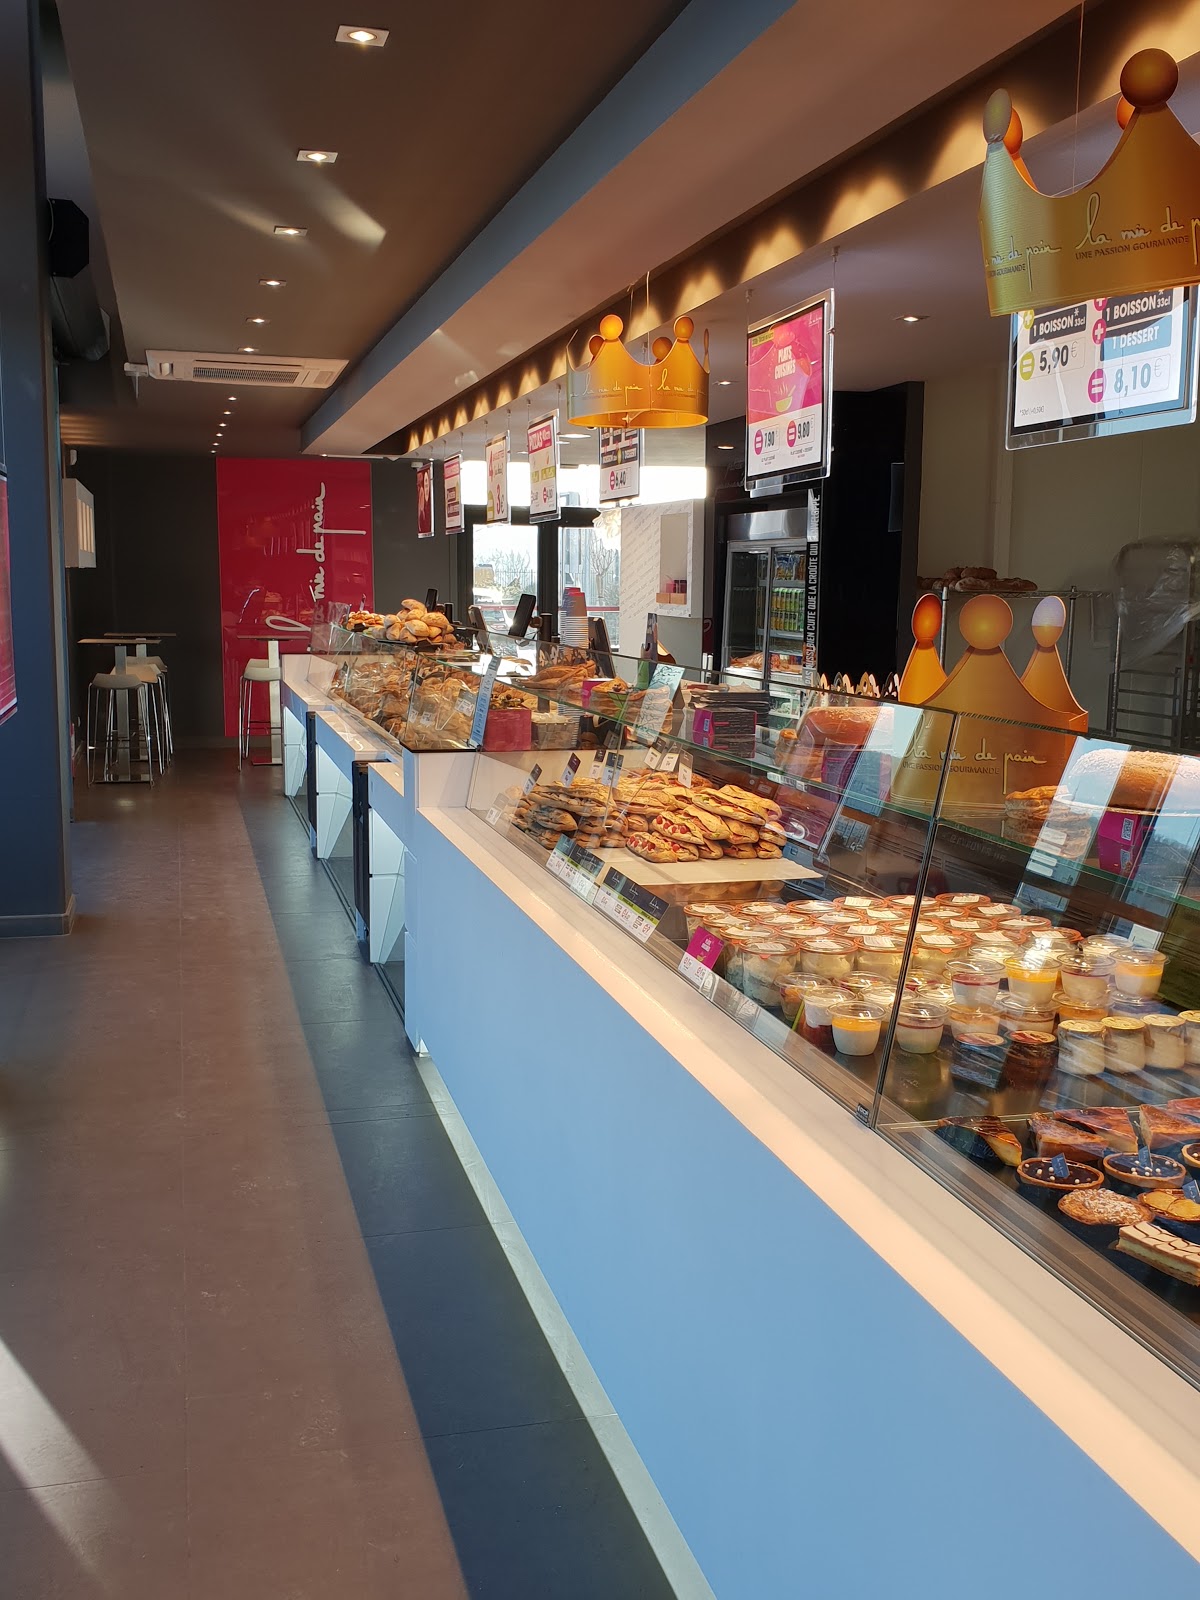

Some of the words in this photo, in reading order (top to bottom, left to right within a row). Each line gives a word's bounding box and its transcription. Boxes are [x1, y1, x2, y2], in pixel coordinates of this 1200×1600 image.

[1075, 192, 1112, 249] la
[1121, 224, 1152, 239] mie
[1160, 206, 1185, 232] de
[1075, 252, 1093, 260] UNE
[1094, 246, 1131, 257] PASSION
[1133, 235, 1189, 251] GOURMANDE
[1026, 240, 1061, 292] pain
[1106, 309, 1111, 321] 1
[1113, 295, 1156, 320] BOISSON
[1033, 325, 1037, 337] 1
[1039, 314, 1073, 335] BOISSON
[1112, 337, 1117, 350] 1
[1119, 325, 1160, 349] DESSERT
[296, 535, 325, 562] de
[312, 482, 367, 534] pain
[809, 543, 819, 555] QUI
[808, 557, 818, 584] CROÛTE
[807, 596, 817, 609] QUE
[808, 586, 817, 594] LA
[806, 611, 816, 630] CUITE
[974, 738, 997, 761] de
[1003, 750, 1047, 794] pain
